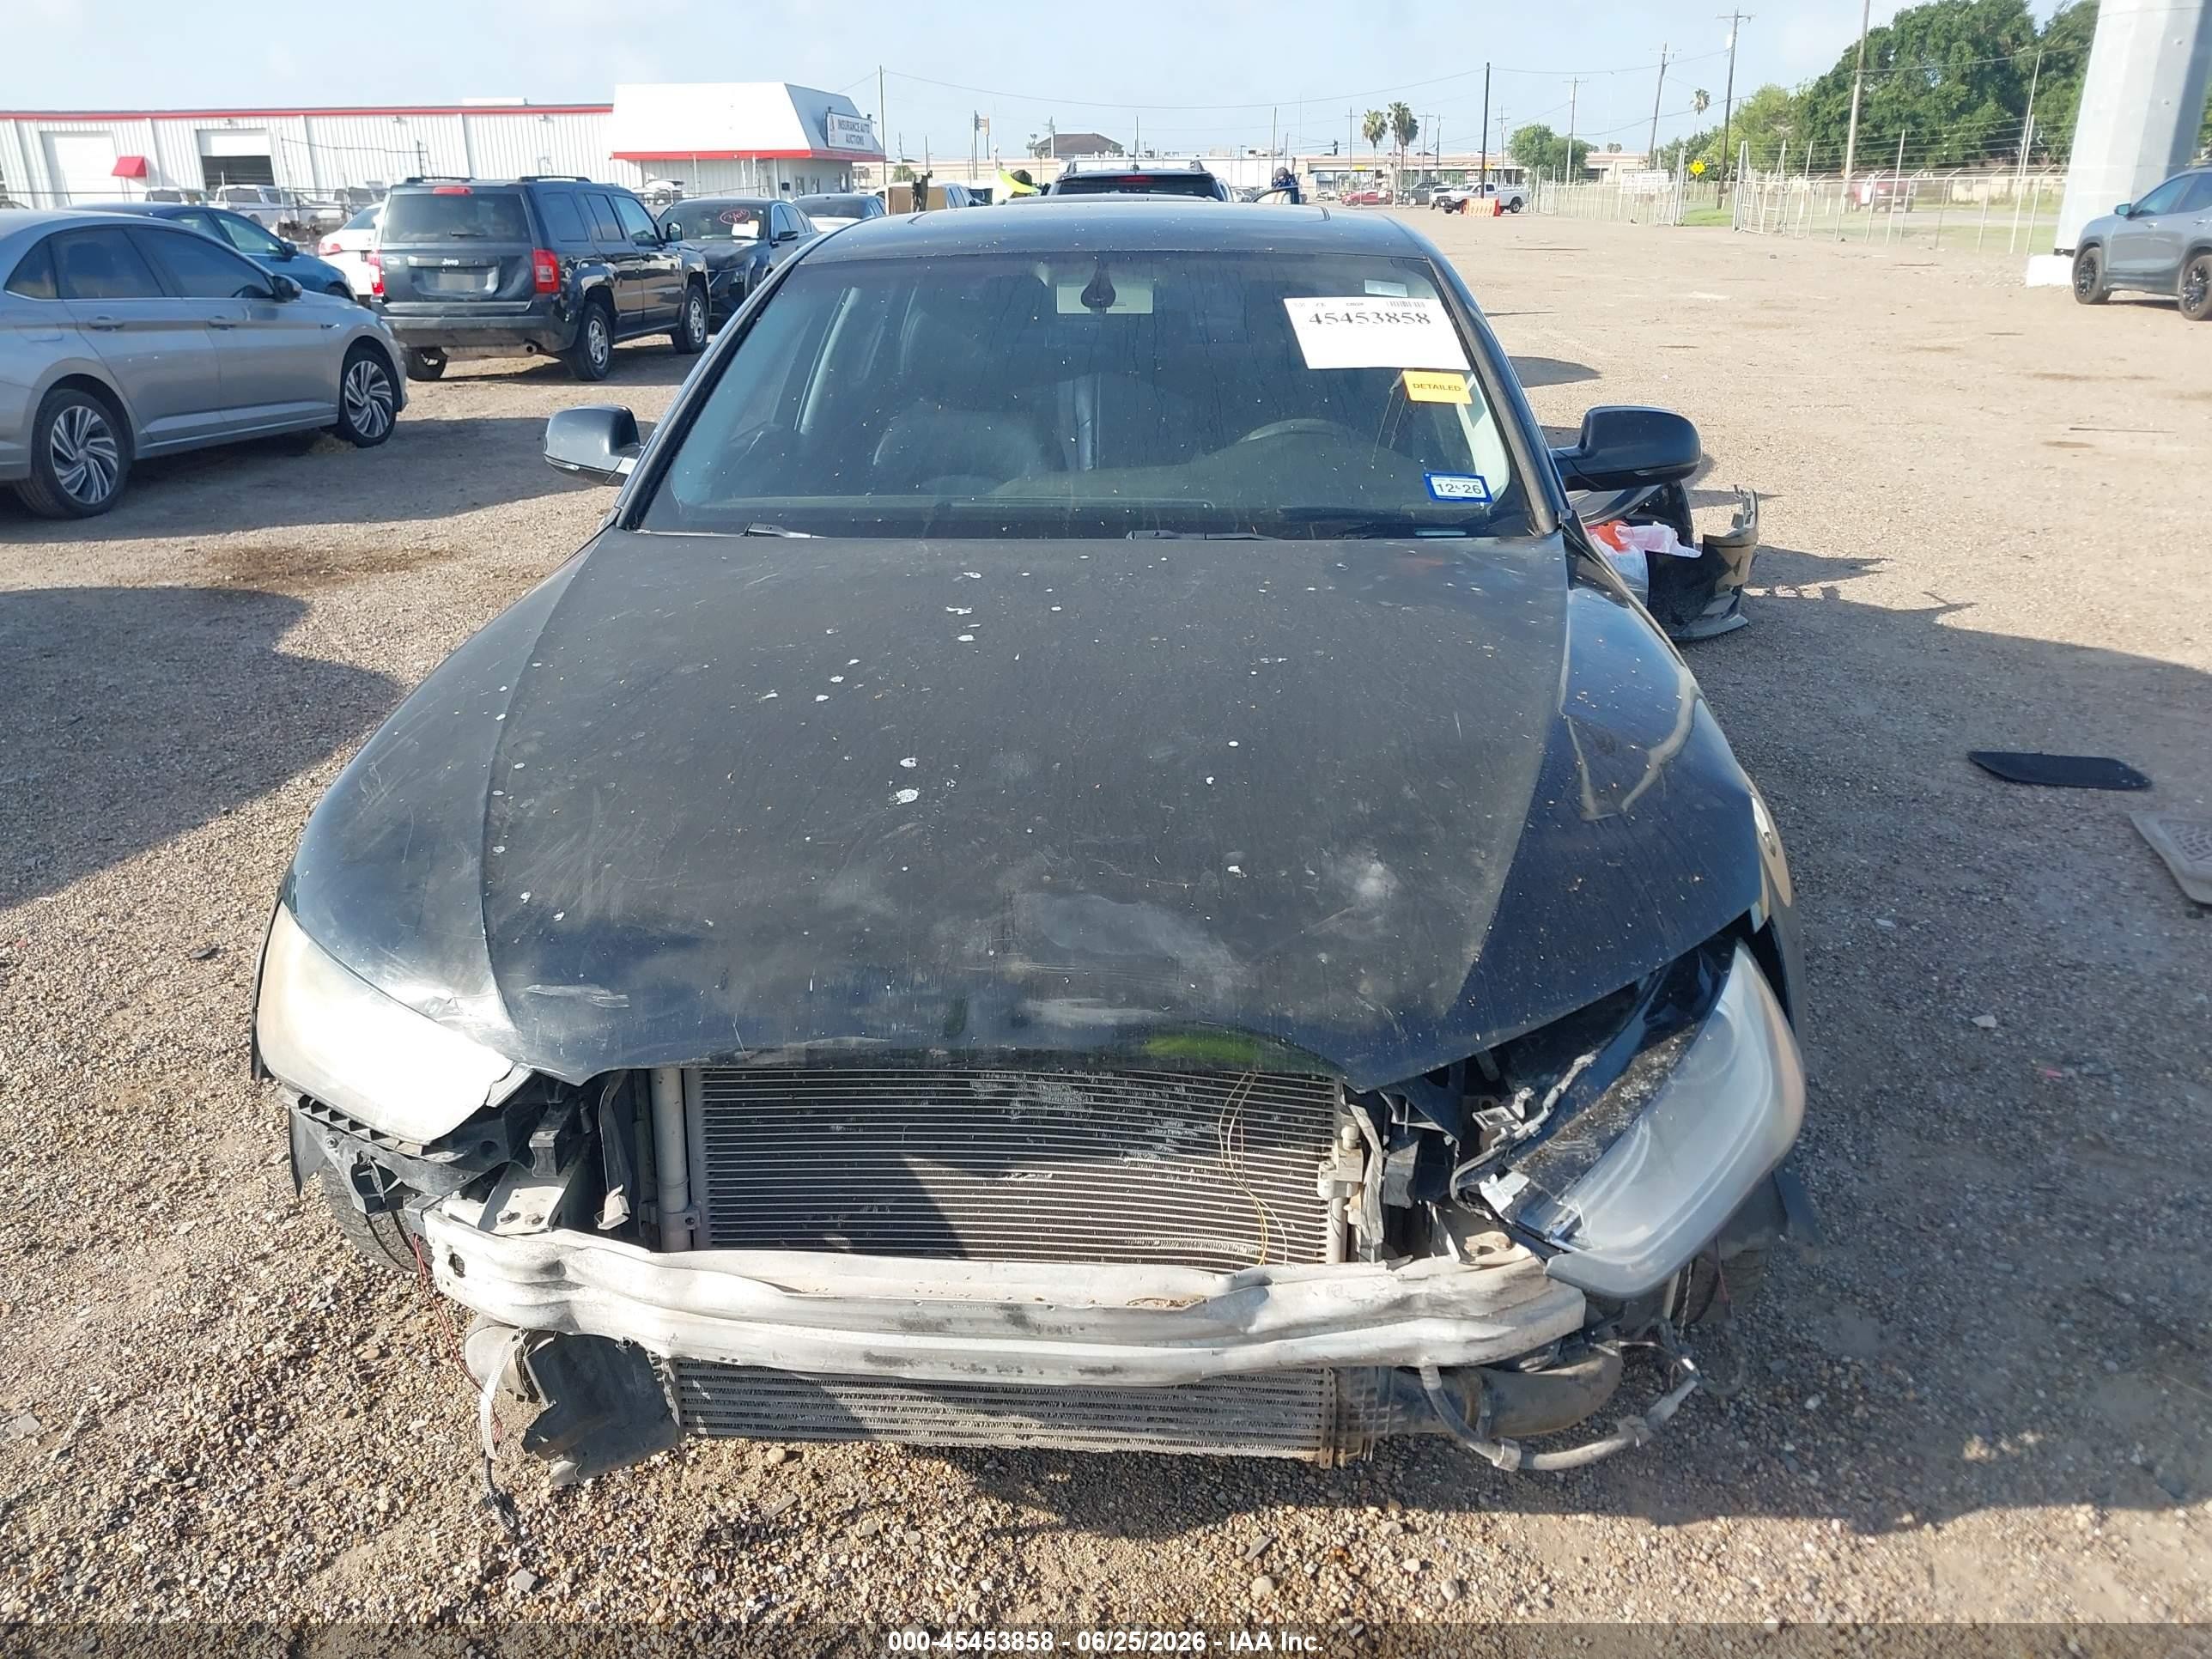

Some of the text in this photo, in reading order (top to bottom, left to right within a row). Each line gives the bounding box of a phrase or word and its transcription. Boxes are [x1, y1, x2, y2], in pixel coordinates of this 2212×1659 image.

[441, 258, 459, 266] Jeep
[1309, 312, 1431, 325] 45453858
[1413, 383, 1462, 392] DETAILED
